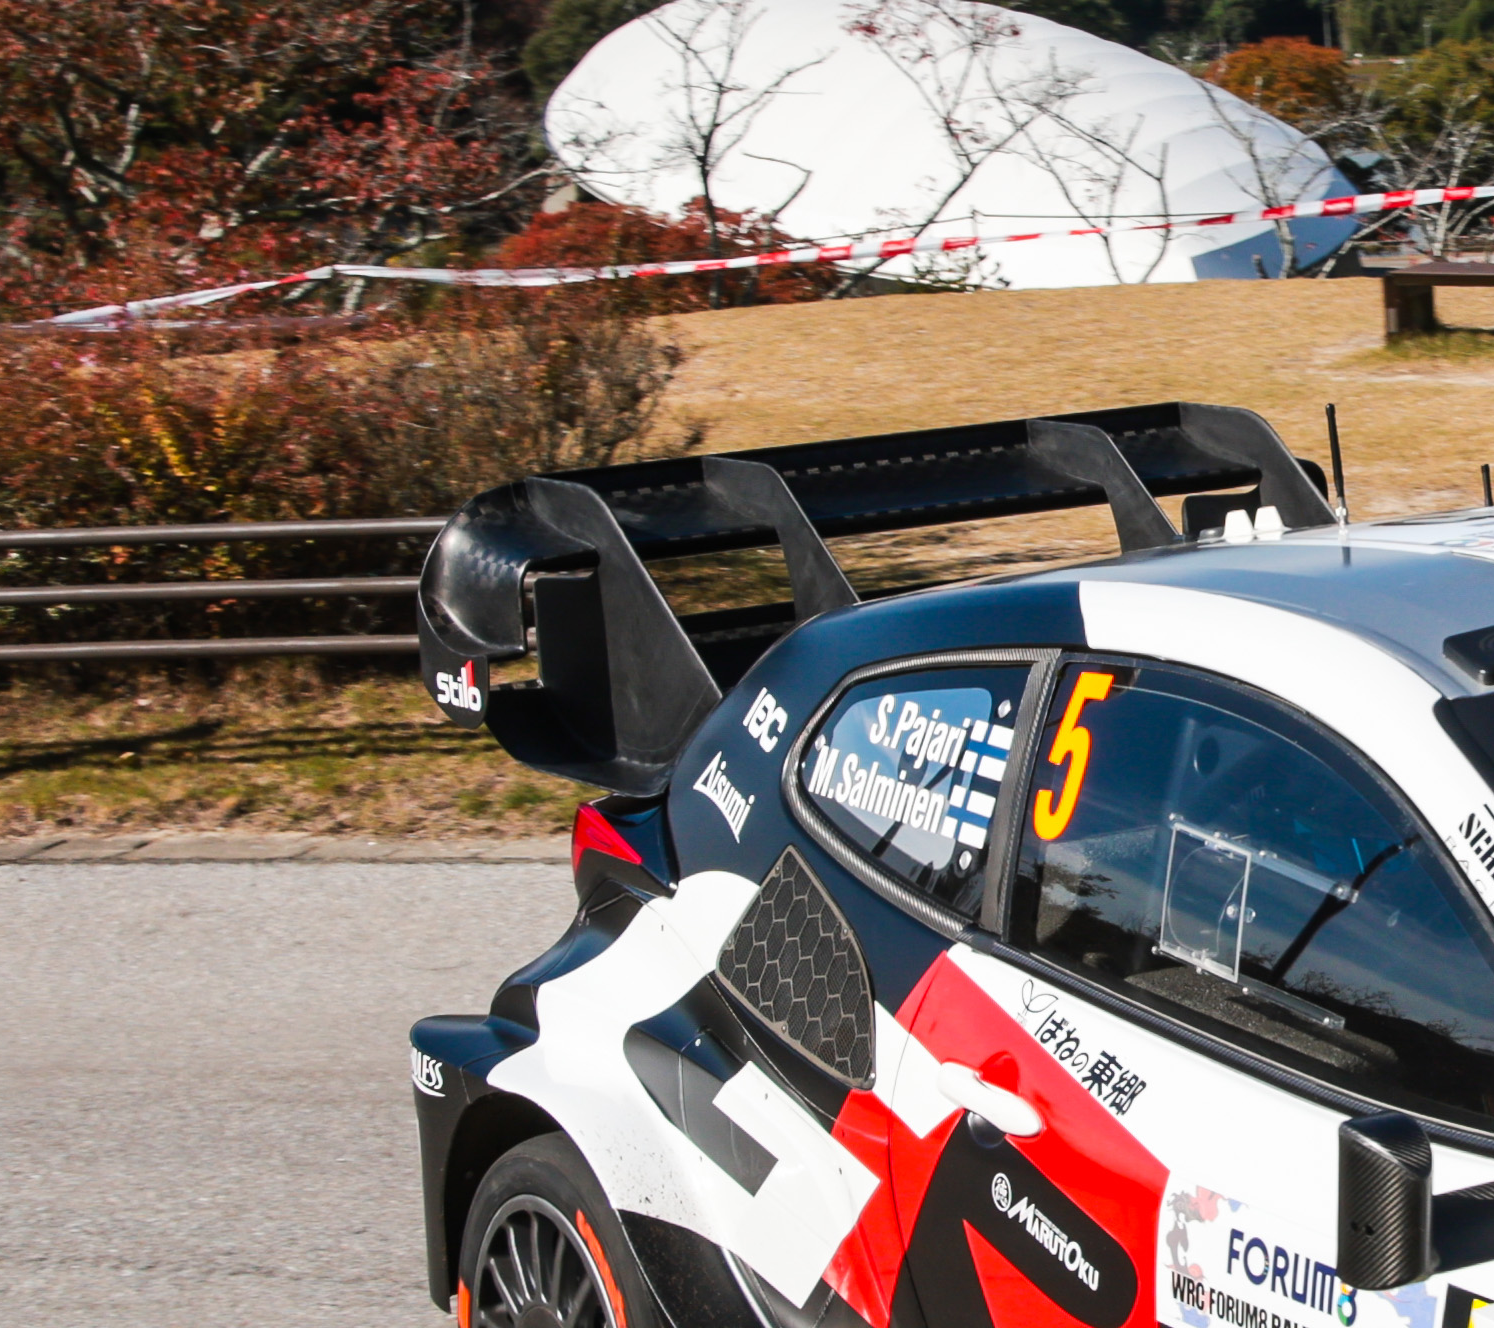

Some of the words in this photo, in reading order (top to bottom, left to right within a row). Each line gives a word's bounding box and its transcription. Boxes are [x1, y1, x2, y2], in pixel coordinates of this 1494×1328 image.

[436, 664, 482, 712] Stilo
[869, 693, 972, 770] S.Pajari
[1033, 671, 1115, 841] 5
[808, 745, 949, 833] M.Salminen
[1034, 1010, 1147, 1116] ばねの東郷
[1170, 1271, 1206, 1312] WRC
